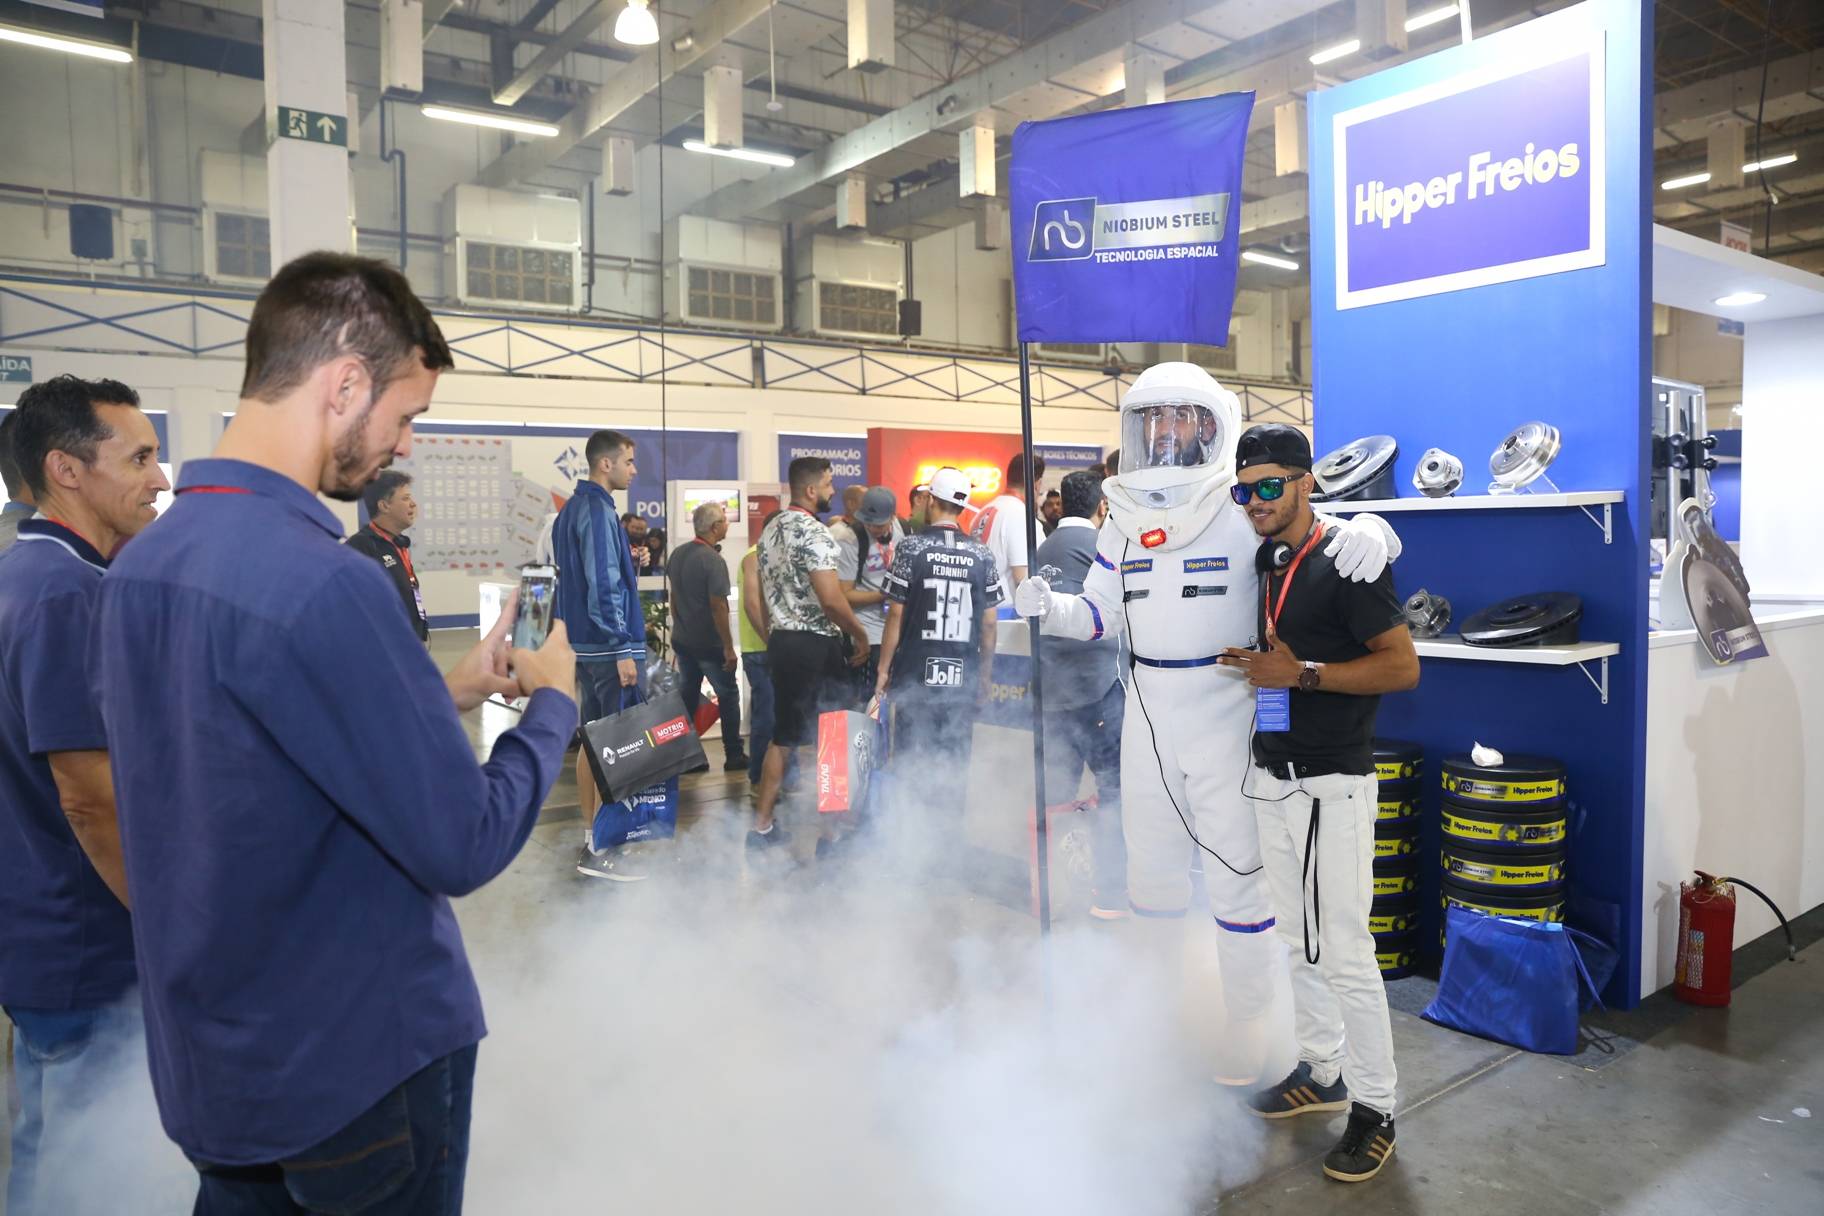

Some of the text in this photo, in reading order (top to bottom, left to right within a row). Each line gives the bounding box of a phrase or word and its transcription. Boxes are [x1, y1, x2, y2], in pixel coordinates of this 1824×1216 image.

[1355, 142, 1581, 229] Hipper Freios
[1103, 211, 1220, 234] NIOBIUM STEEL
[1095, 245, 1219, 264] TECNOLOGIA ESPACIAL
[0, 356, 31, 371] ÍDA
[790, 448, 861, 461] PROGRAMAÇÃO
[830, 461, 862, 477] ÓRIOS
[926, 552, 974, 567] POSITIVO
[922, 577, 974, 643] 38
[926, 664, 962, 685] Joli
[991, 684, 1026, 704] pper
[657, 721, 684, 737] MOTRIO
[616, 739, 645, 754] RENAULT
[1536, 785, 1553, 794] Freios
[1471, 825, 1493, 835] Freios
[1500, 870, 1526, 880] Hipper
[1525, 870, 1544, 878] Freios
